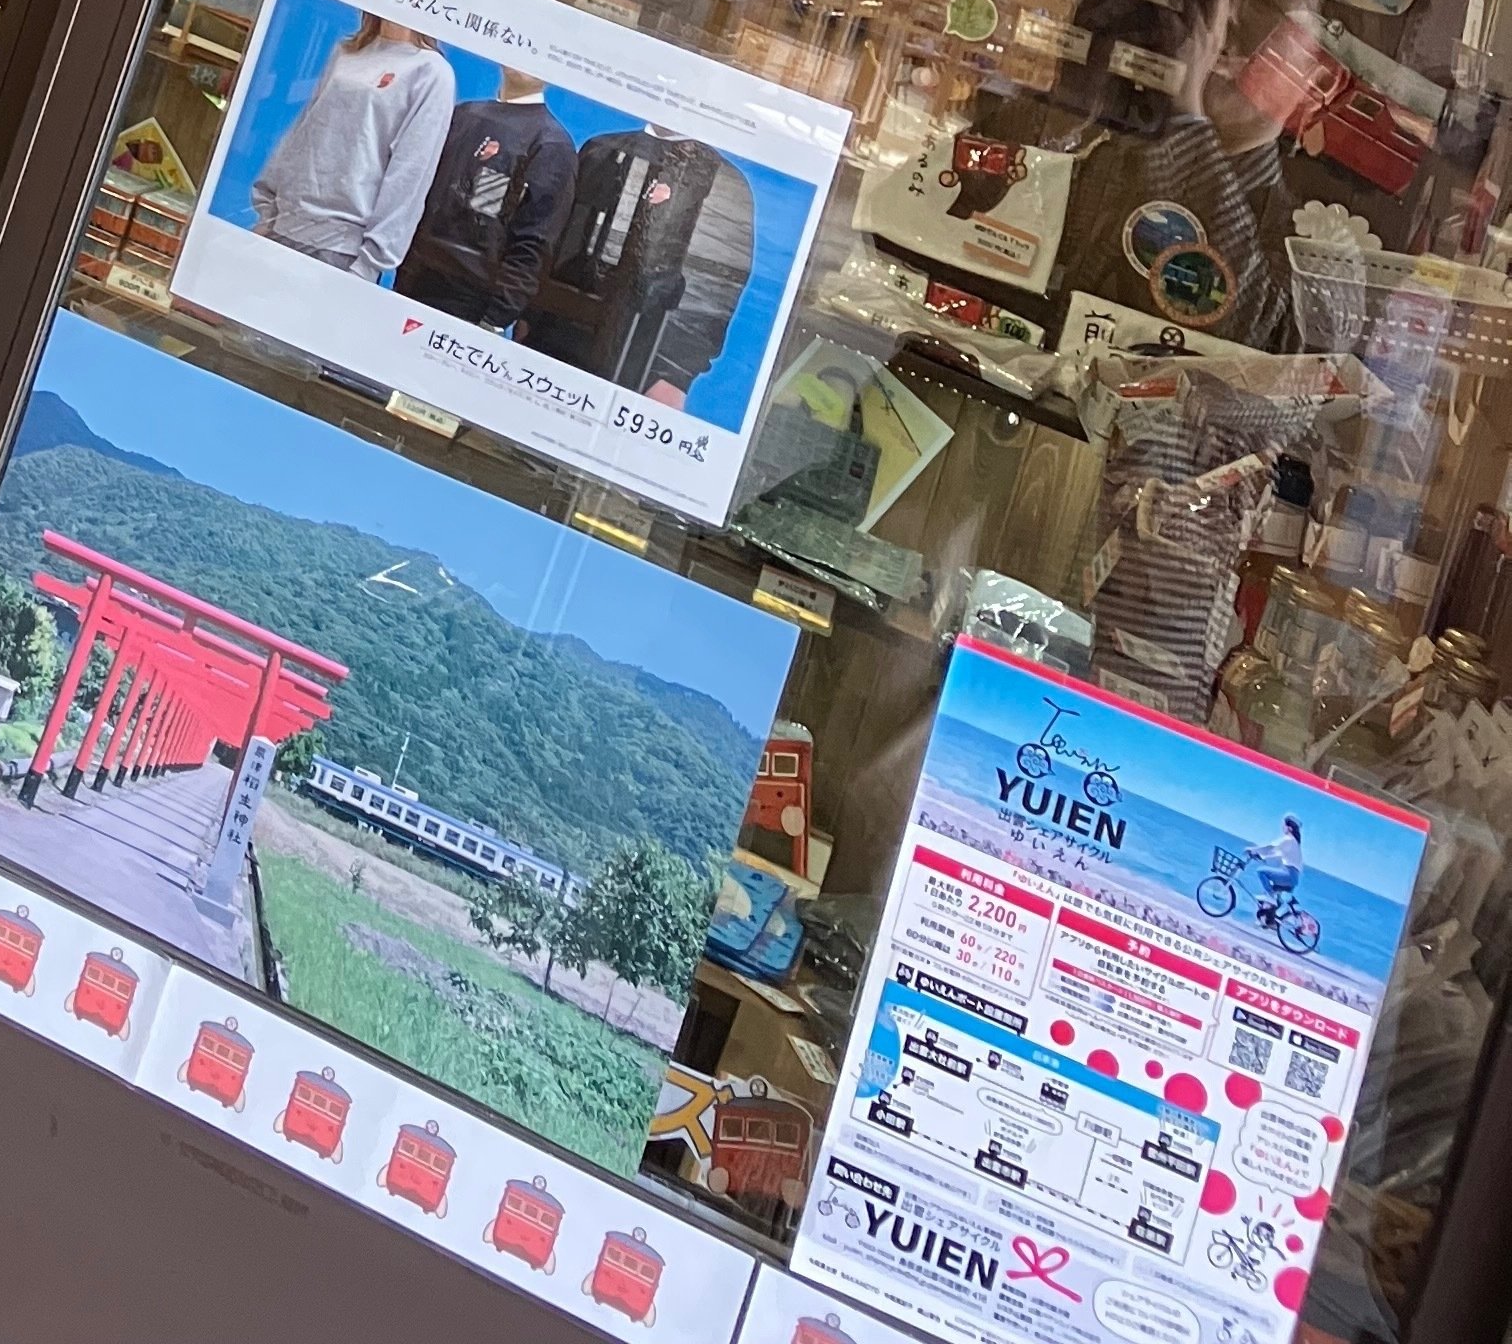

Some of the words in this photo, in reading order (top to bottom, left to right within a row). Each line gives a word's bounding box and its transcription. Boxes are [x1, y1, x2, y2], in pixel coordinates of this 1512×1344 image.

[517, 367, 596, 413] スウェット
[996, 767, 1127, 849] YUIEN
[997, 806, 1113, 864] 出雲シェアサイクル
[1008, 827, 1089, 871] ゆいえん
[927, 876, 964, 897] 最大料金
[959, 868, 1006, 896] 利用料金
[1125, 939, 1152, 959] 予約
[1233, 985, 1350, 1042] アプリをダウンロード
[864, 1198, 1001, 1291] YUIEN
[900, 1199, 1002, 1253] 出雲シェアサイクル
